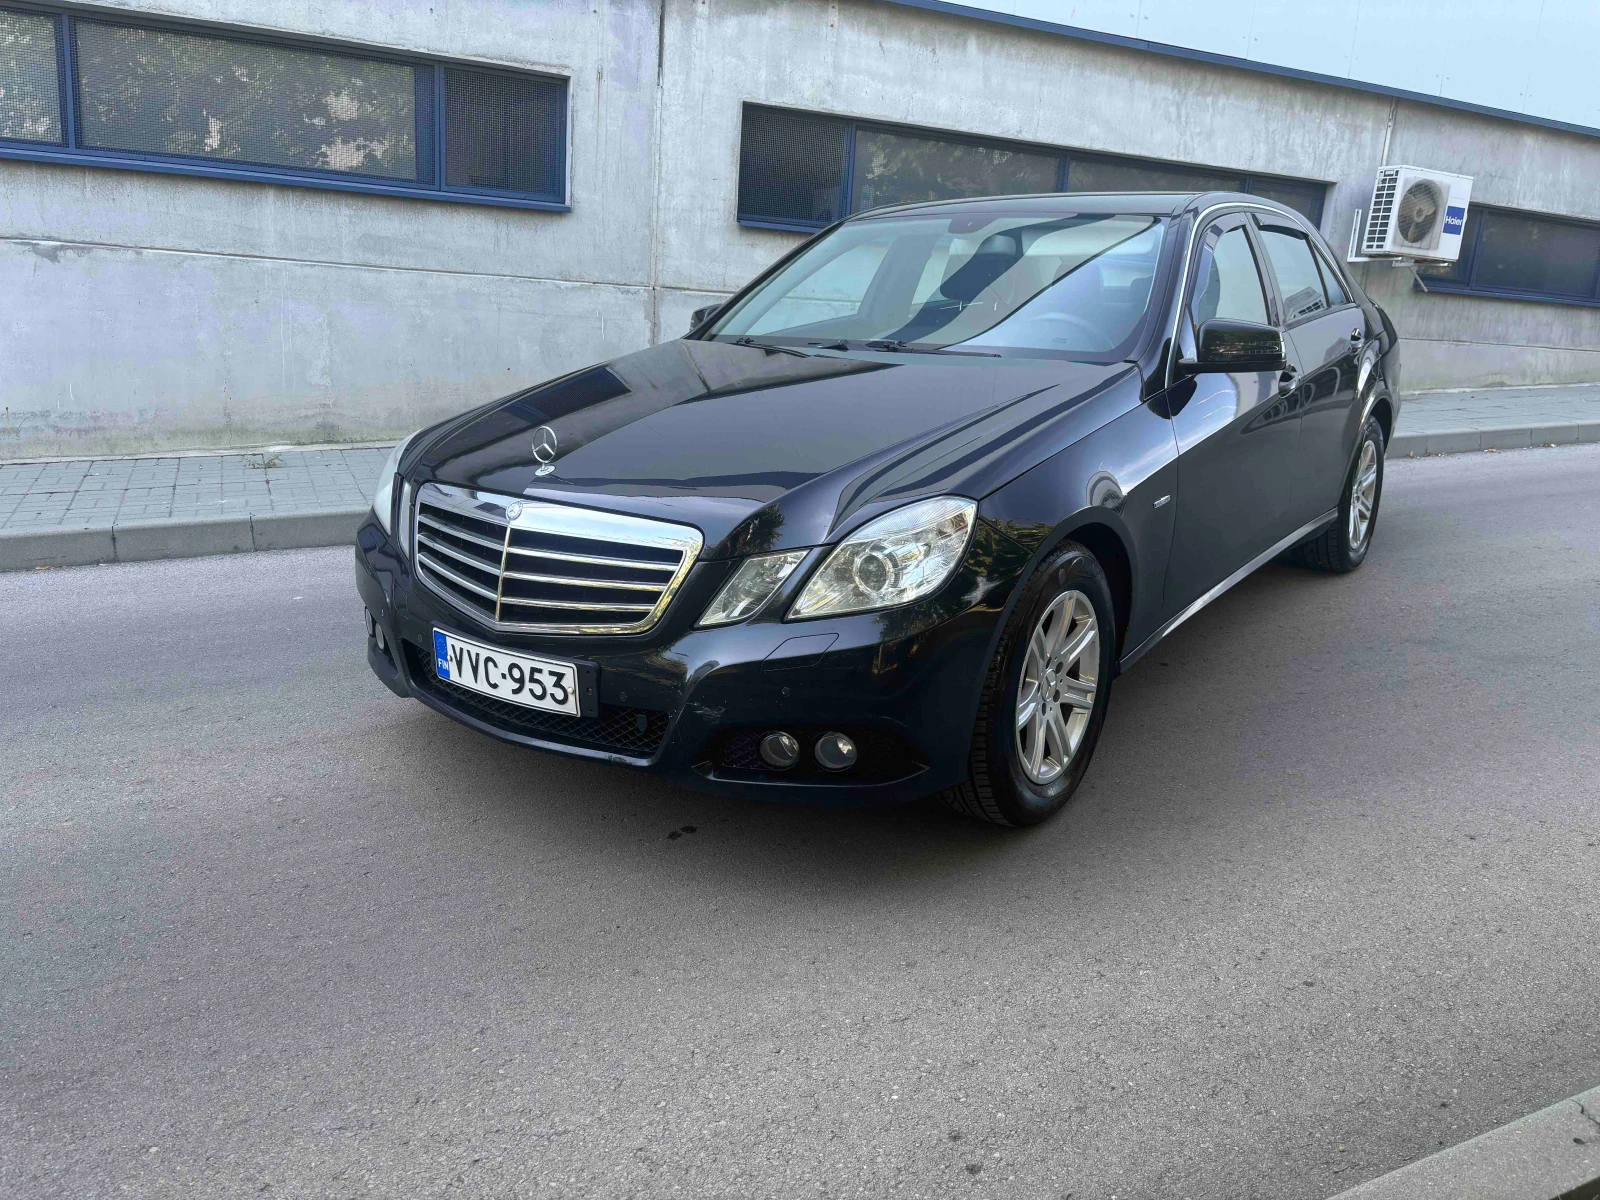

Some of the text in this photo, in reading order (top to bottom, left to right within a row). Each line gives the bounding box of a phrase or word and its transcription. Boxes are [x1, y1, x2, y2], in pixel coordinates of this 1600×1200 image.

[1445, 215, 1462, 226] Haier
[438, 658, 449, 671] FIN
[451, 643, 569, 705] VVC-953
